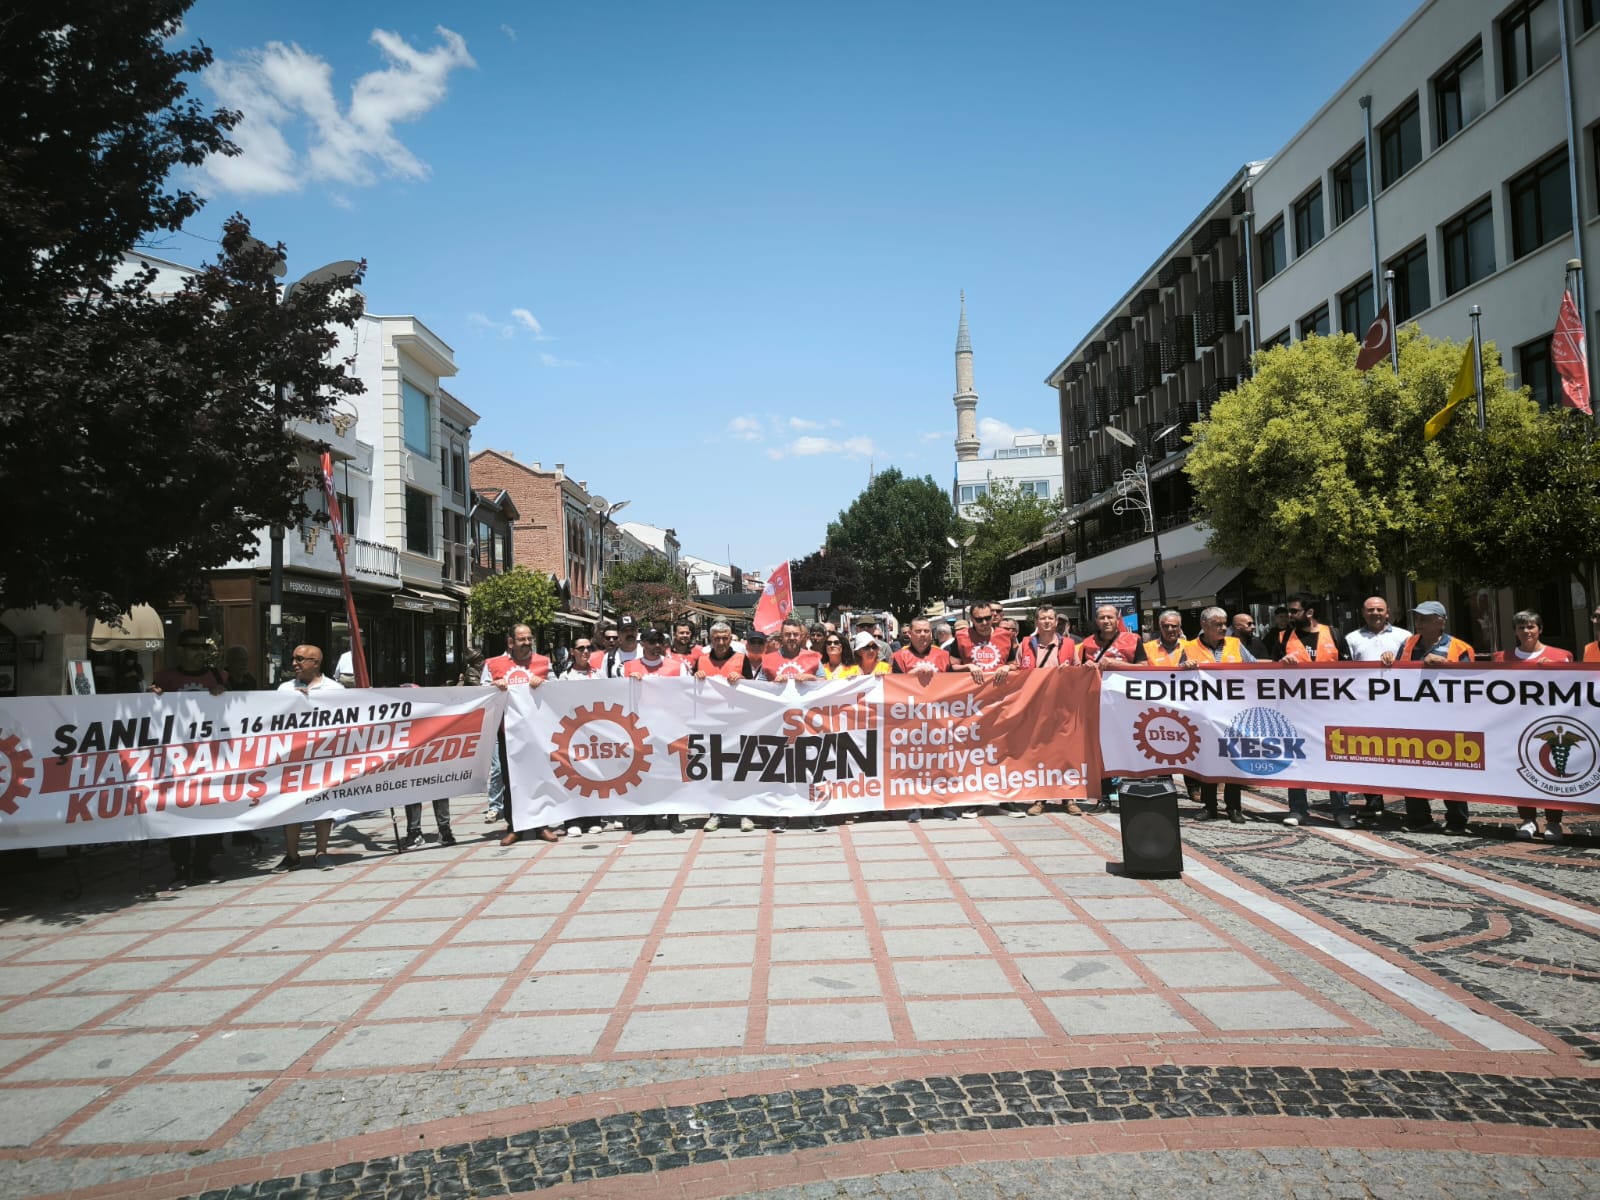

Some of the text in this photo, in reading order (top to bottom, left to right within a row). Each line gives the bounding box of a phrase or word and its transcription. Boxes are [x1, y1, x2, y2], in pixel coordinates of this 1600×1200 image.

[1125, 673, 1246, 701] EDİRNE
[1256, 677, 1358, 701] EMEK
[889, 693, 984, 721] ekmek
[52, 714, 175, 766] ŞANLI
[189, 720, 213, 740] 15
[240, 716, 263, 734] 16
[270, 706, 360, 731] HAZİRAN
[367, 701, 412, 721] 1970
[303, 721, 412, 759] İZİNDE
[889, 719, 981, 746] adalet
[1148, 725, 1188, 743] DİSK
[1328, 727, 1481, 763] tmmob
[572, 734, 630, 762] DİSK
[709, 729, 878, 785] HAZİRAN
[889, 743, 999, 773] hürriyet
[1218, 737, 1307, 760] KESK
[889, 762, 1088, 797] mücadelesine!
[1249, 761, 1275, 772] 1995
[1523, 766, 1538, 785] TÜRK
[1540, 782, 1577, 794] TABİPLERİ
[65, 770, 268, 824] KURTULUŞ
[331, 784, 373, 800] TRAKYA
[376, 779, 408, 792] BÖLGE
[410, 769, 473, 788] TEMSİLCİLİĞİ
